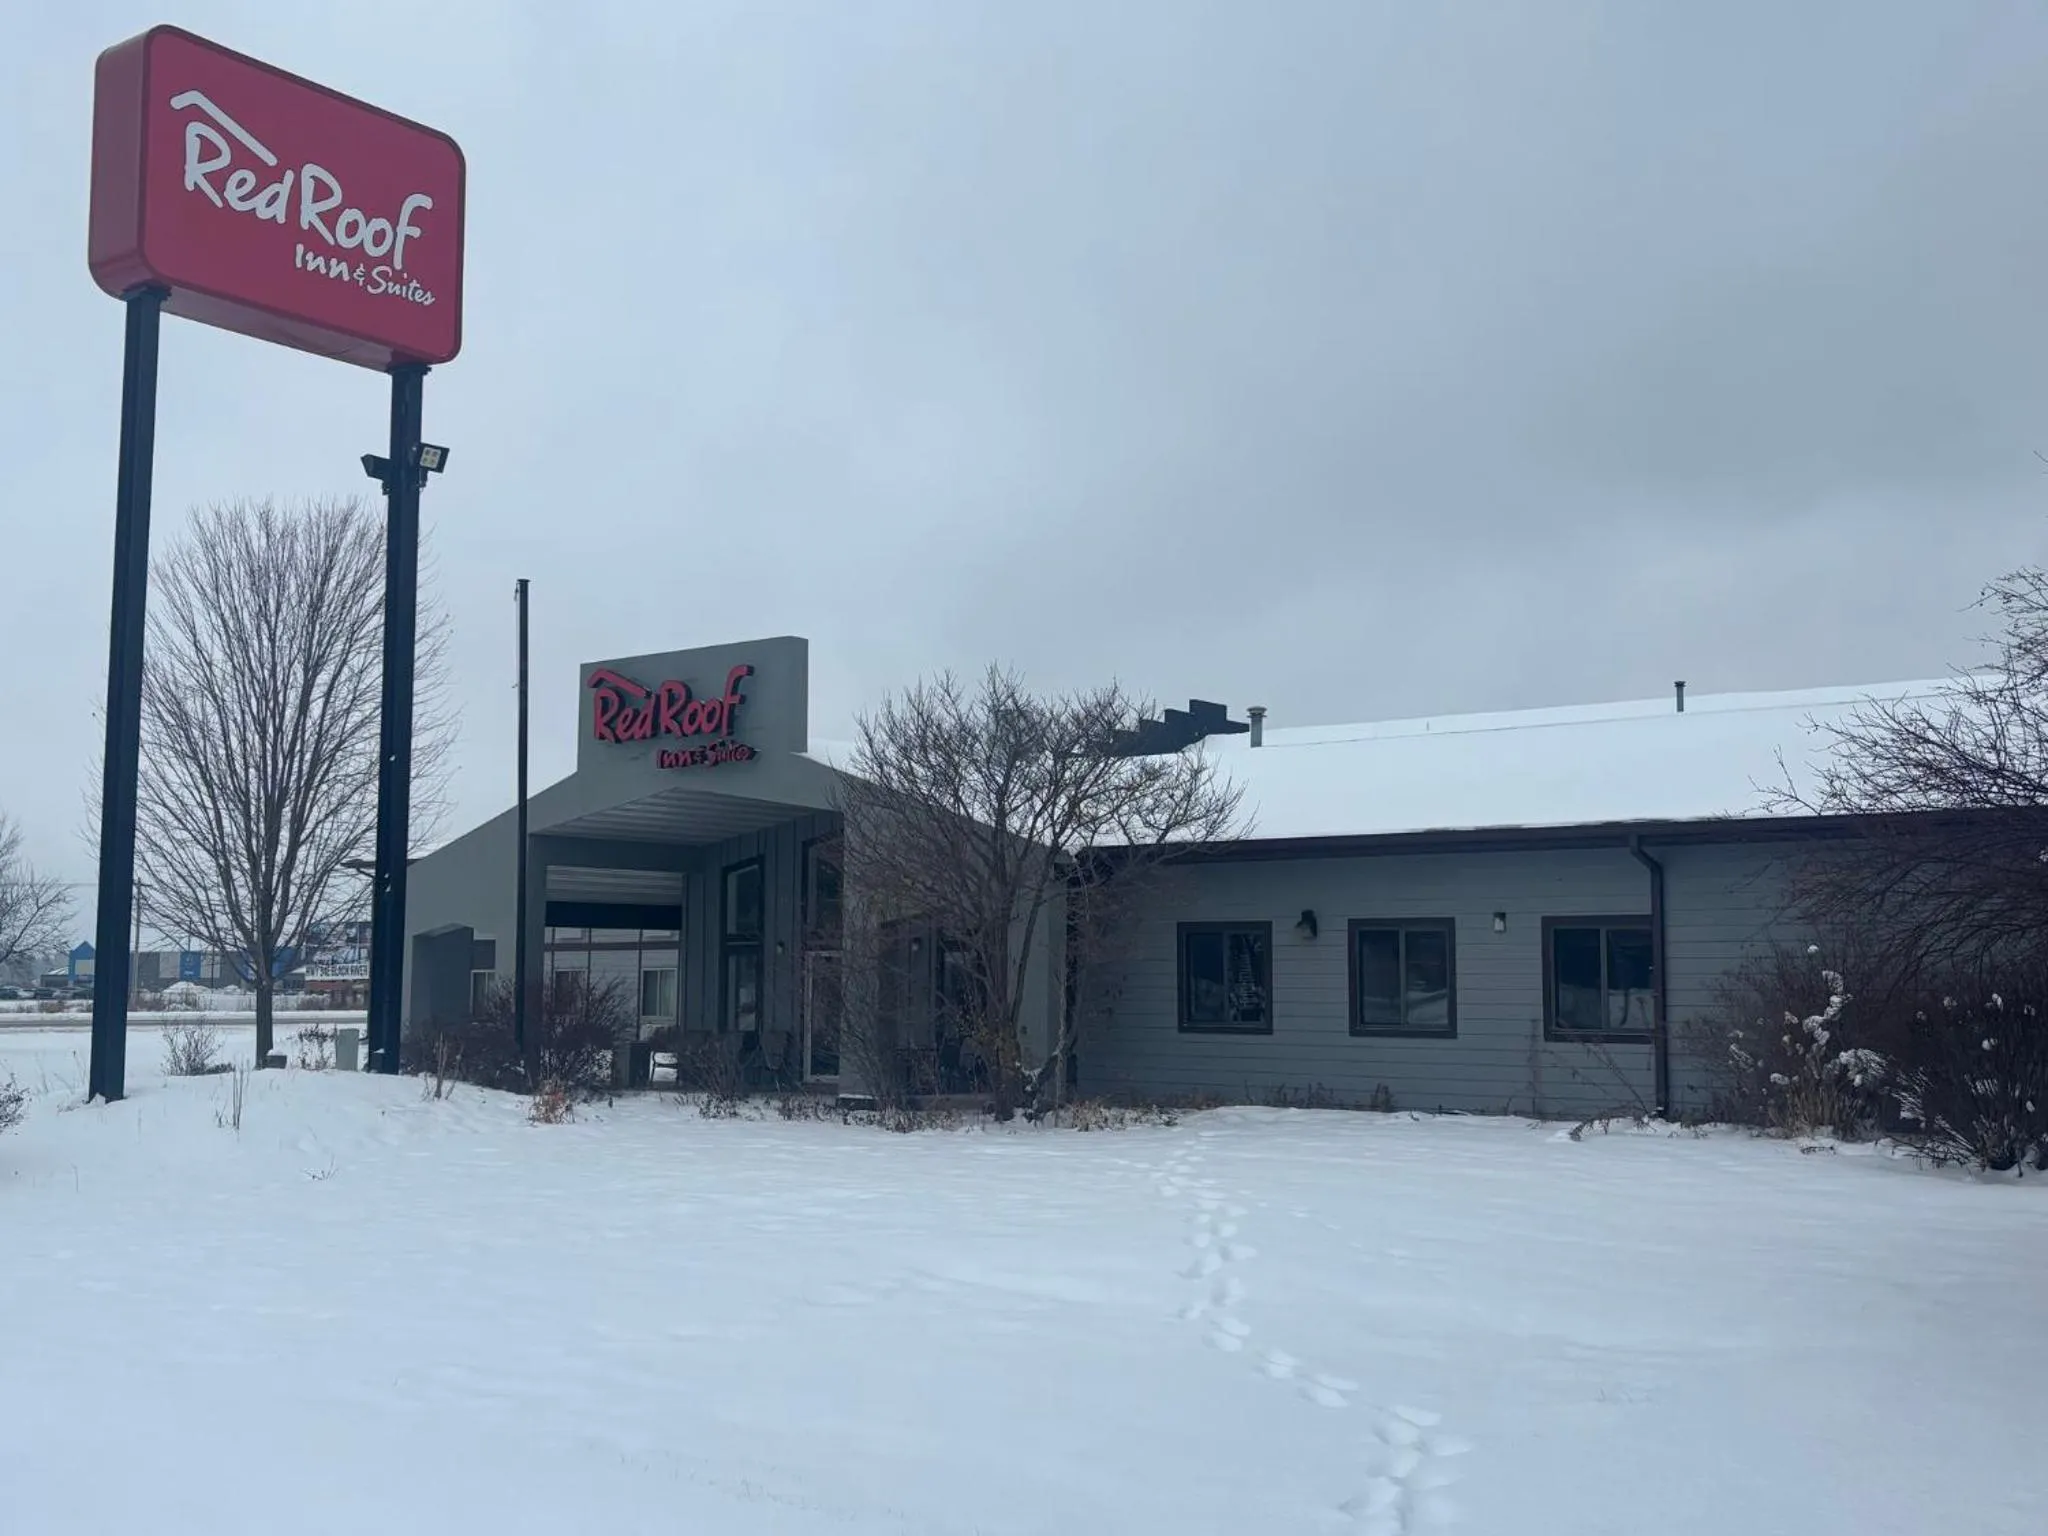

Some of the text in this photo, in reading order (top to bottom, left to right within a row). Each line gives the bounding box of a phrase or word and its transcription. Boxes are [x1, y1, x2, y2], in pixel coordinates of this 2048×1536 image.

[184, 120, 433, 270] Red Roof
[295, 243, 436, 305] Inn & Suites
[593, 665, 754, 743] Red Roof
[656, 748, 692, 769] Inn
